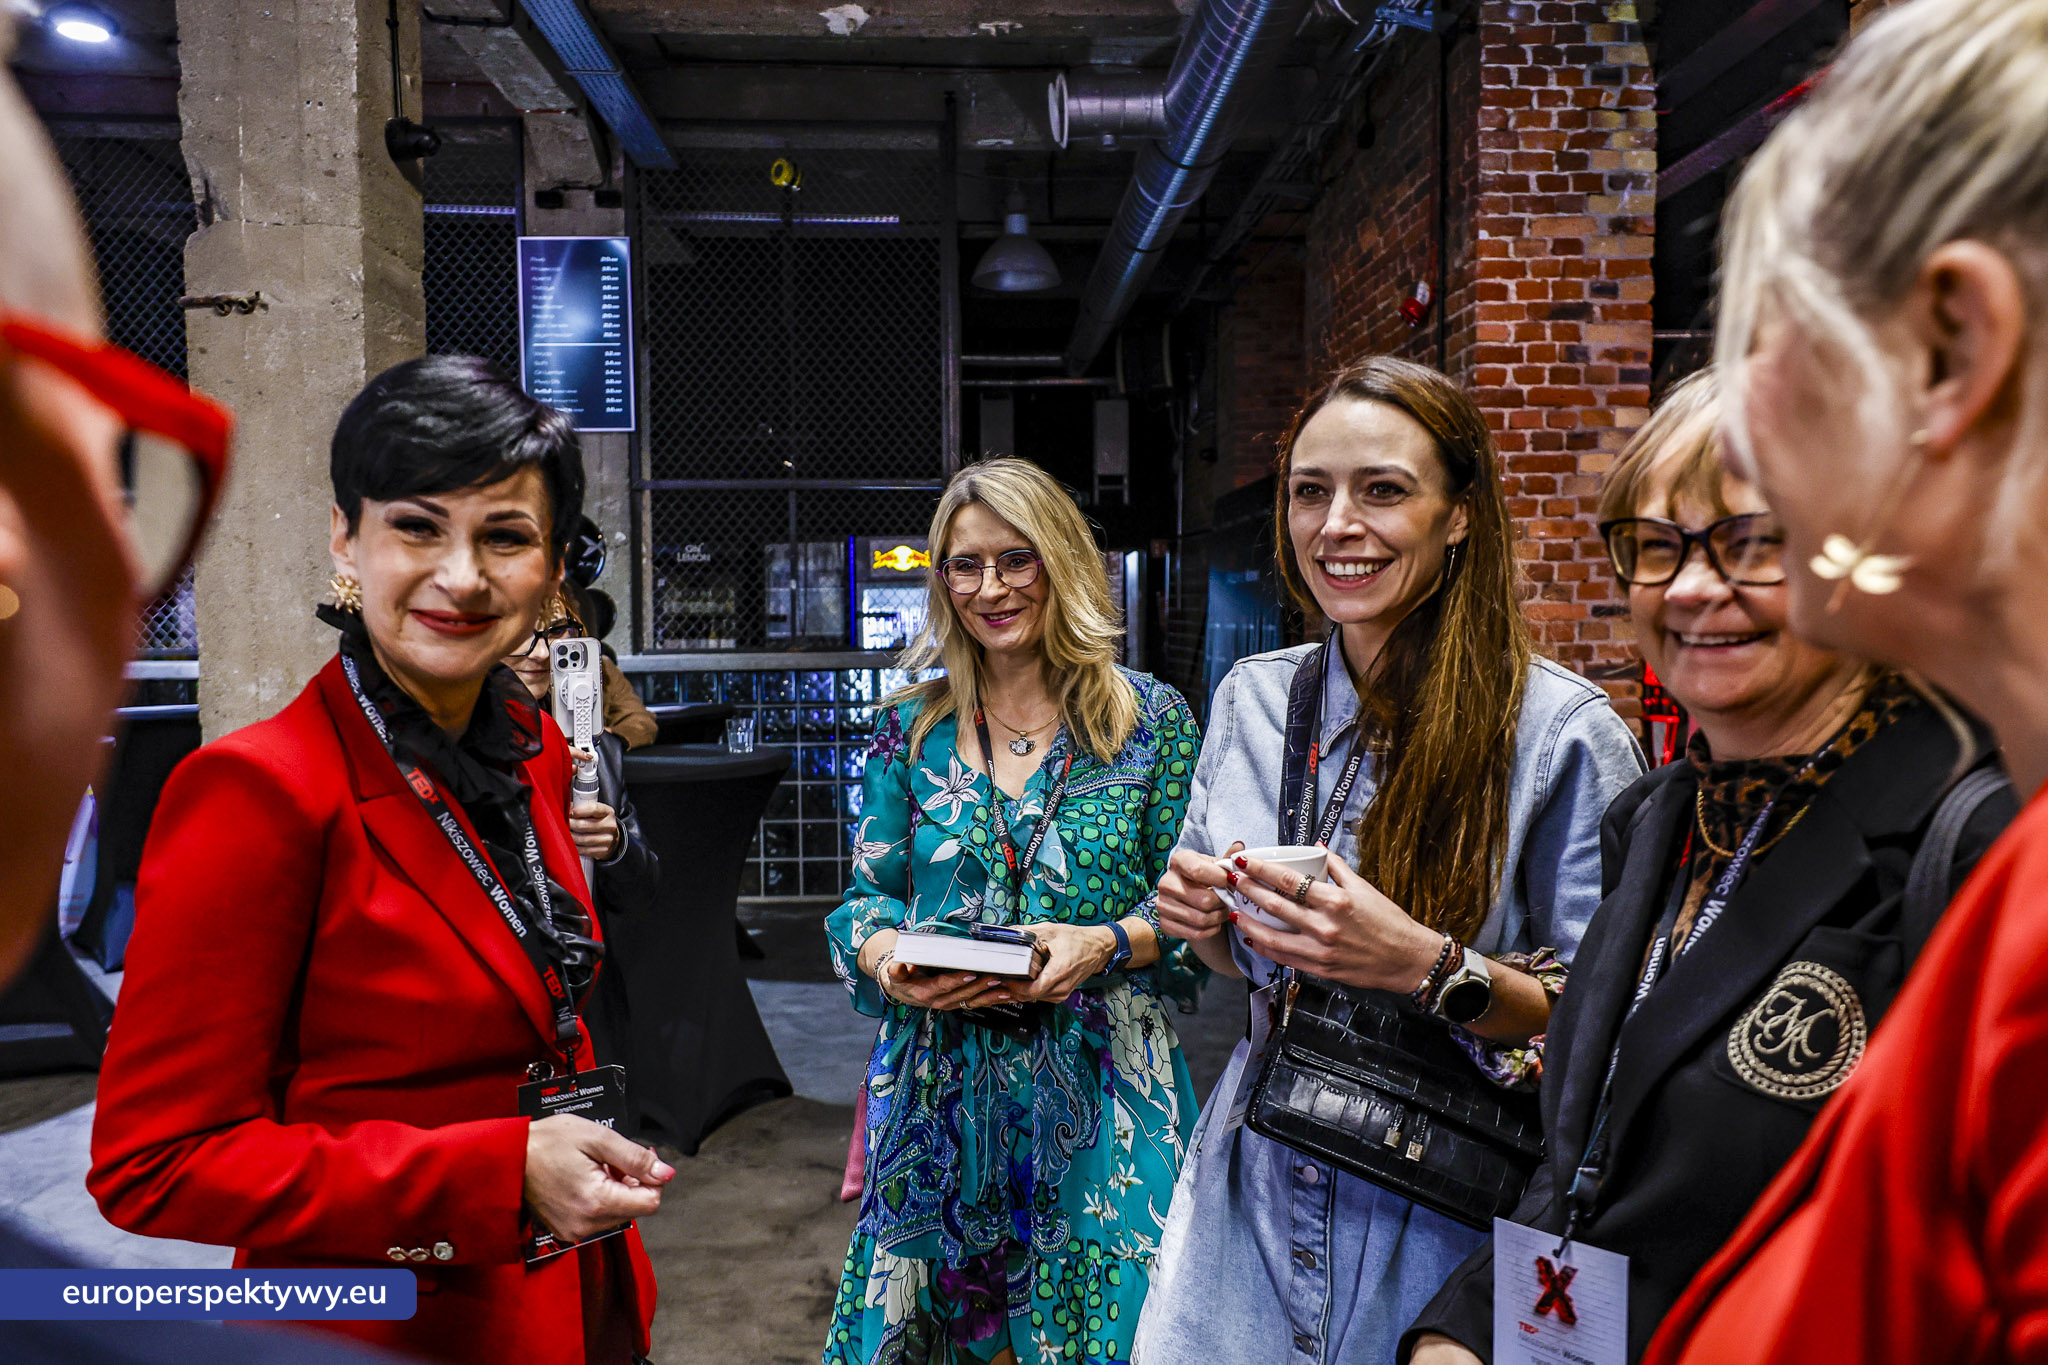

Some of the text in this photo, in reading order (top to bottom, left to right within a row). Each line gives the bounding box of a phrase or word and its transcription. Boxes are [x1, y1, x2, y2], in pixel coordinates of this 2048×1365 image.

[1309, 742, 1320, 774] TEDx
[1037, 781, 1065, 832] Nikiszowiec
[1318, 755, 1361, 844] zowiec Women
[407, 766, 528, 938] TEDx Nikiszowiec Women
[1001, 843, 1016, 870] TEDx
[1022, 832, 1045, 870] Women
[543, 966, 566, 1000] TEDx
[1634, 937, 1667, 1001] Women
[578, 1084, 605, 1096] Women
